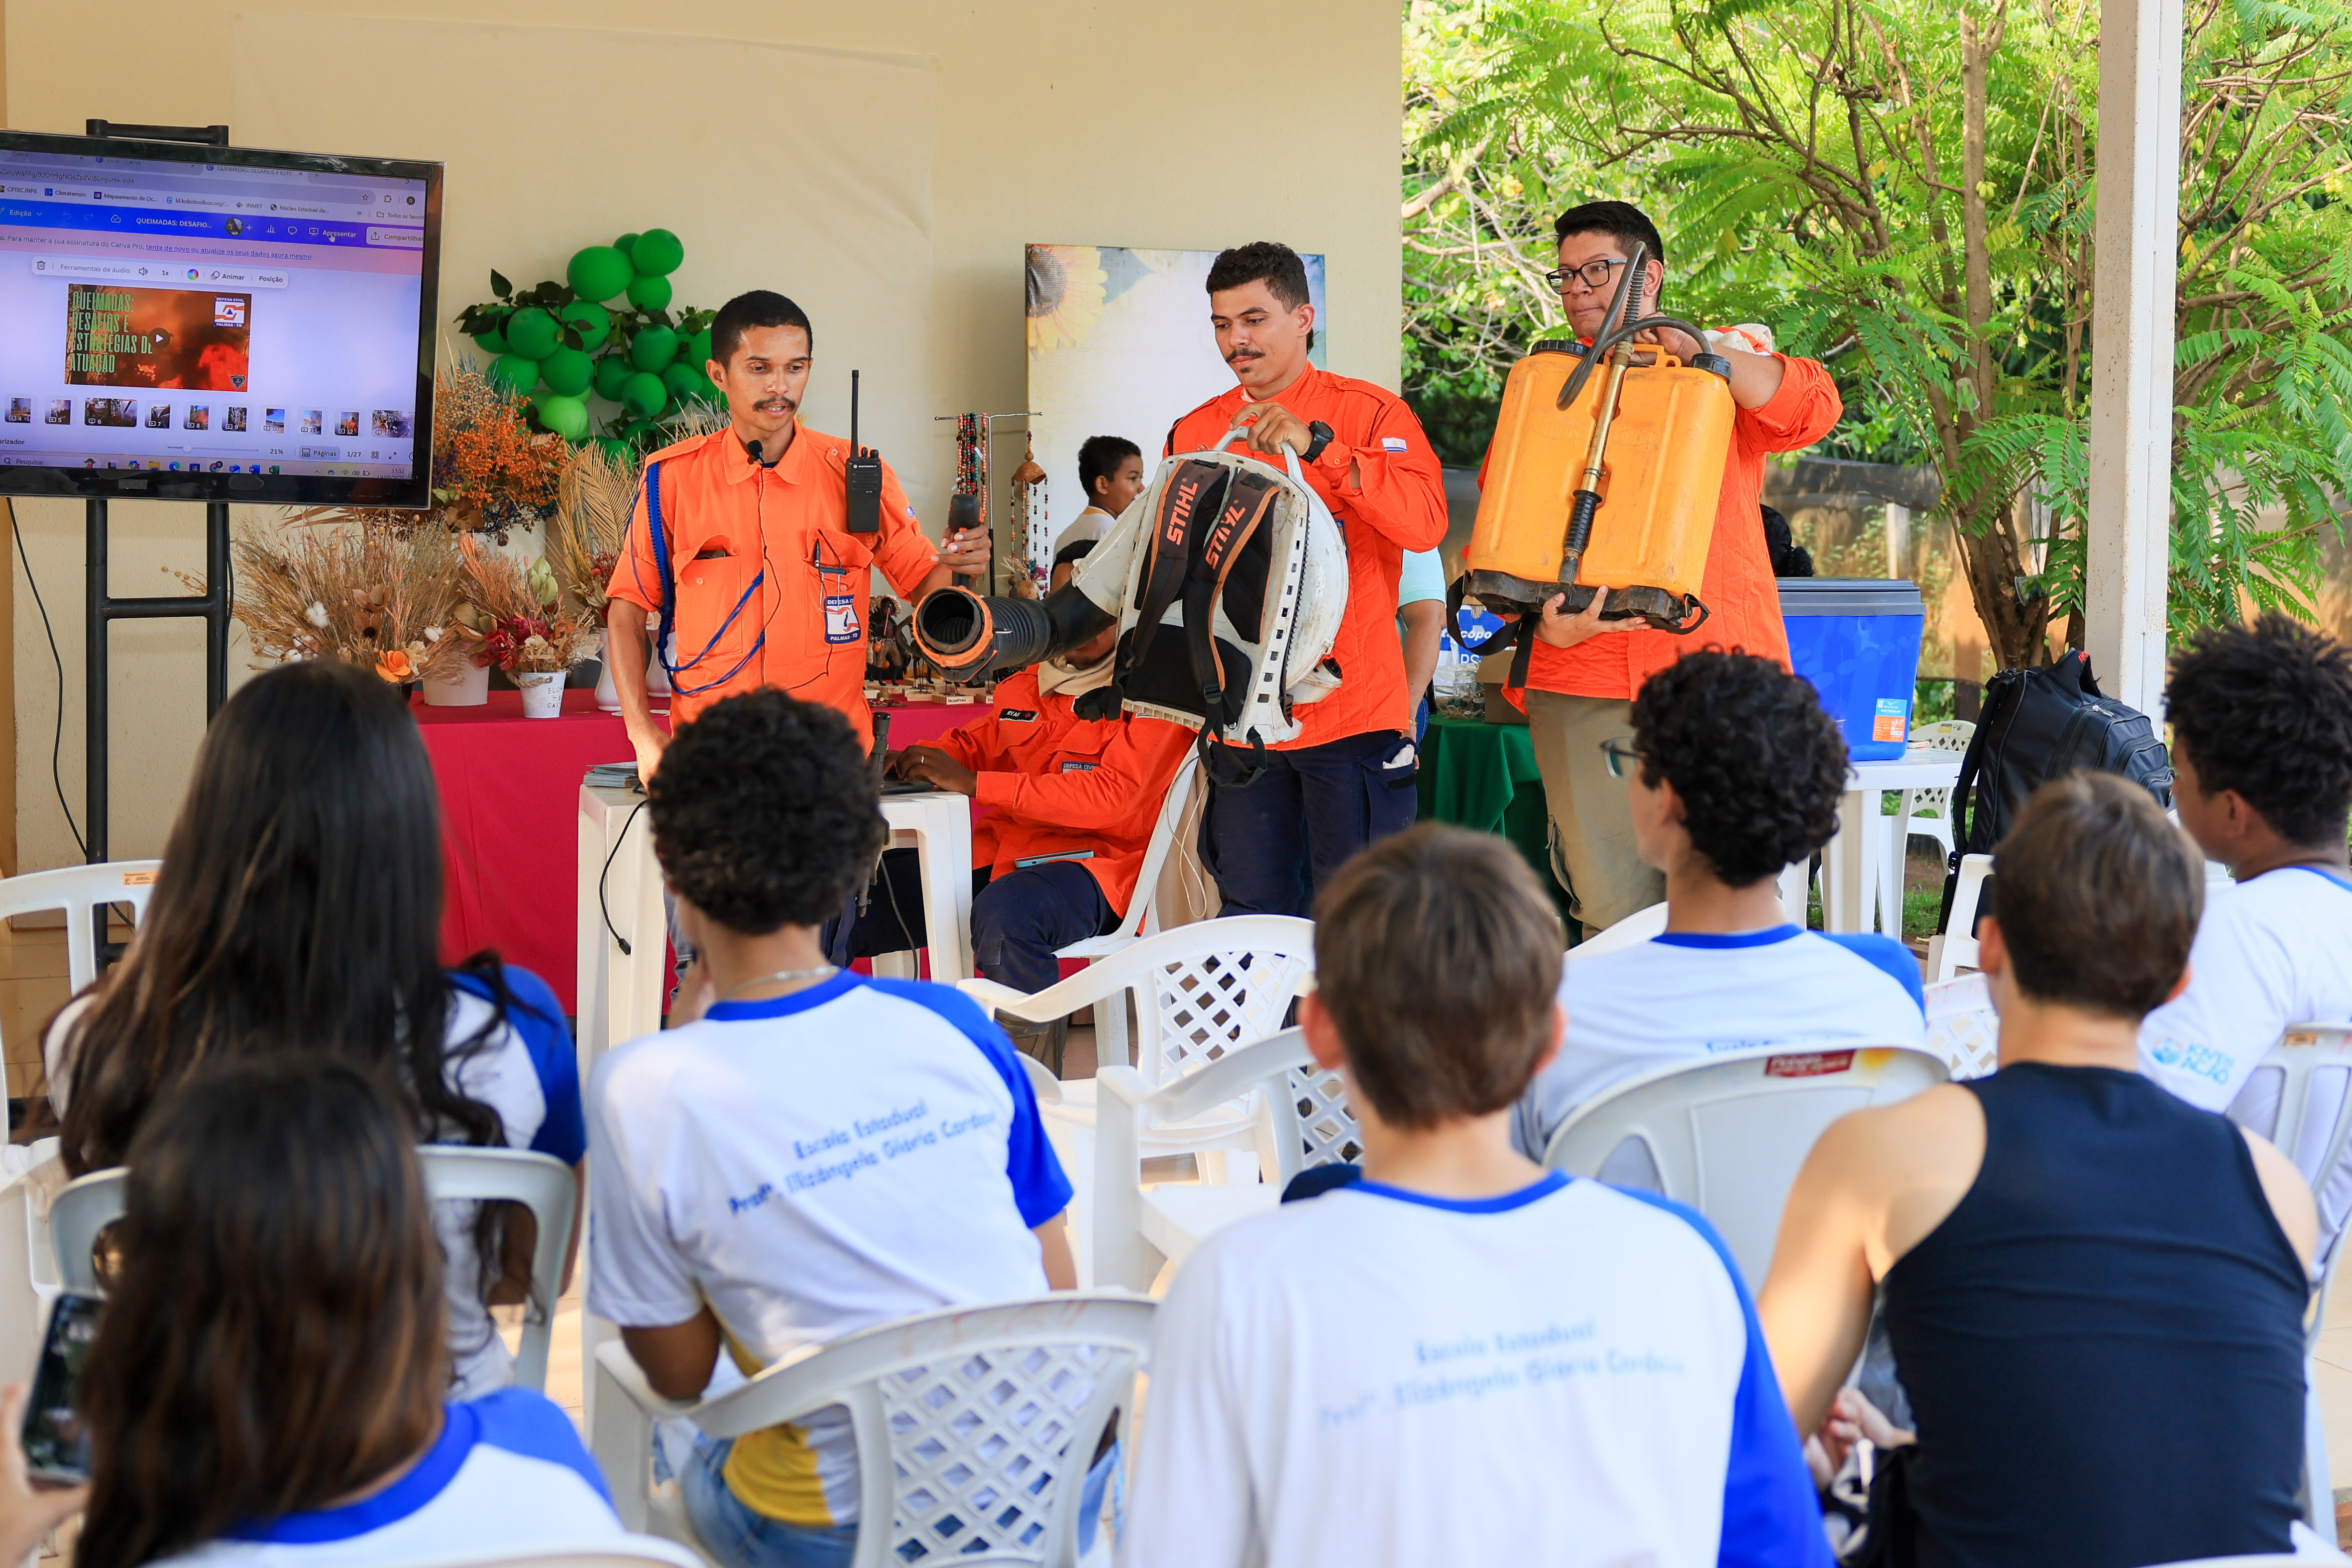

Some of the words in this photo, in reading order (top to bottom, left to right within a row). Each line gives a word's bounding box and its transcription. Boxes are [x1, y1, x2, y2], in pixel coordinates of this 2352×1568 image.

[136, 218, 178, 226] QUEIMADAS:
[60, 264, 101, 272] Ferramentas
[73, 291, 134, 313] QUEIMADAS:
[72, 312, 120, 333] DESAFIOS
[124, 315, 129, 333] E
[71, 331, 137, 353] ESTRATÉGIAS
[70, 352, 115, 375] ATUAÇÃO
[1167, 482, 1199, 546] STIHL
[794, 1129, 850, 1160] Escola
[853, 1098, 929, 1138] Estadual
[1416, 1335, 1486, 1365] Escola
